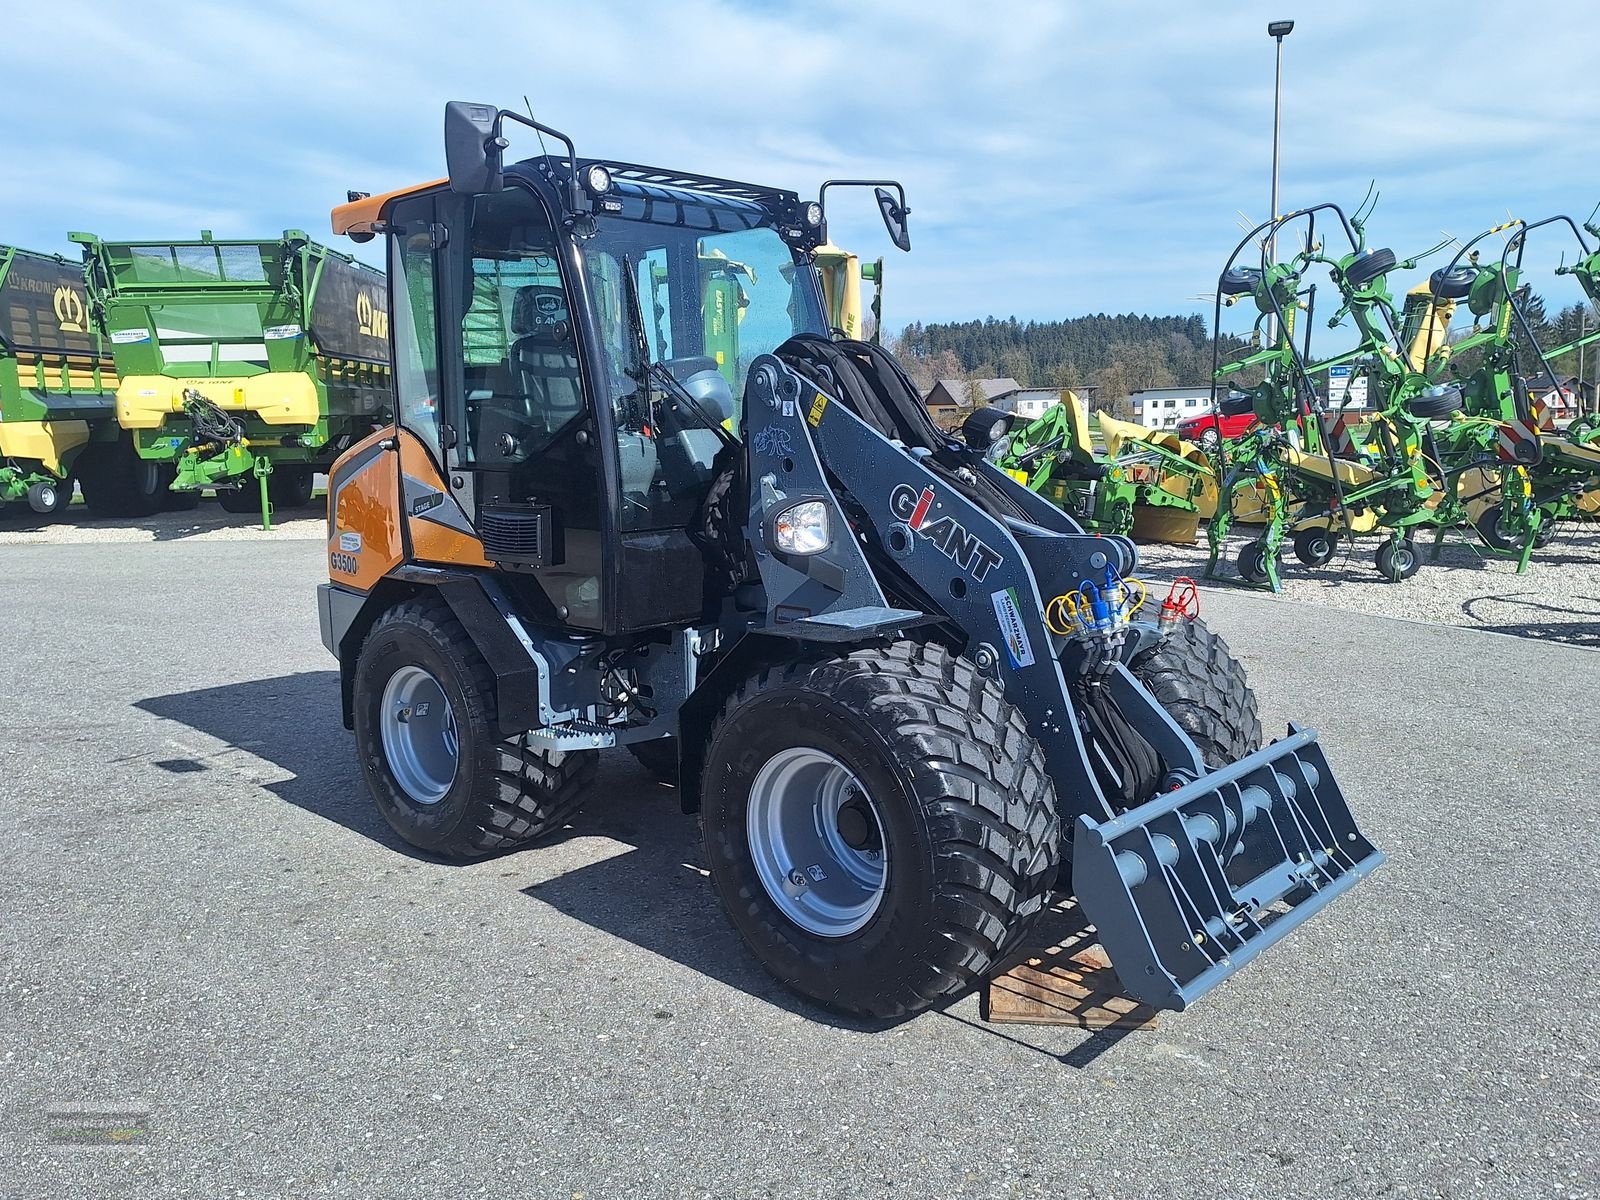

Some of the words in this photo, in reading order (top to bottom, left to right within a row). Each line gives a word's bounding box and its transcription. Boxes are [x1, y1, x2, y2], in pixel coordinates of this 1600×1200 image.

[414, 501, 431, 514] STAGE
[889, 483, 1004, 583] GIANT
[330, 551, 357, 575] G3500
[1004, 595, 1026, 656] SCHWARZMAYR
